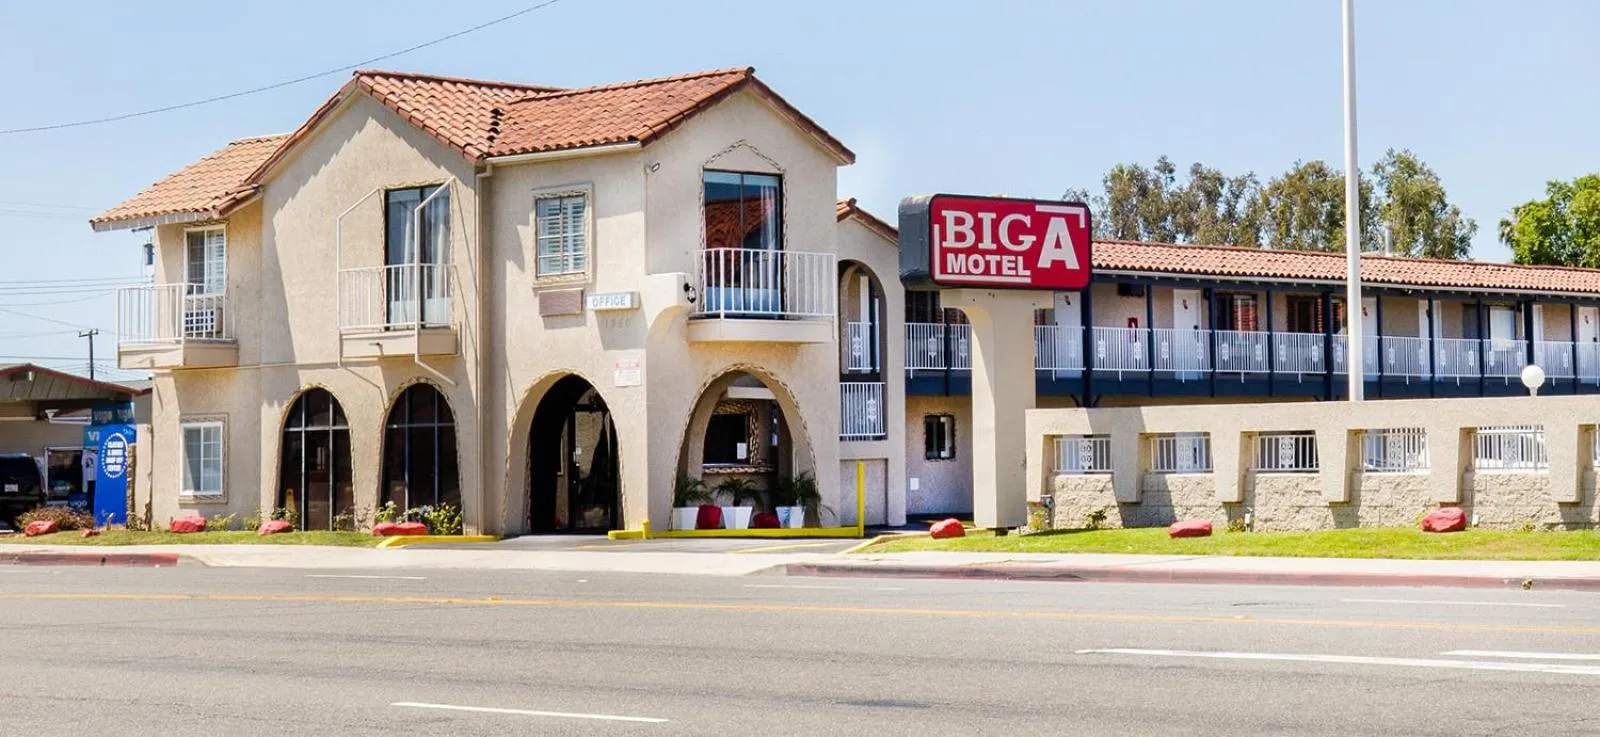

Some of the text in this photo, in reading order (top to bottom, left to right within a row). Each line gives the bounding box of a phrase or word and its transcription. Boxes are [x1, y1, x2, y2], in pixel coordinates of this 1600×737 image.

[941, 210, 1080, 269] BIG A
[947, 253, 1031, 276] MOTEL
[592, 296, 626, 307] OFFICE
